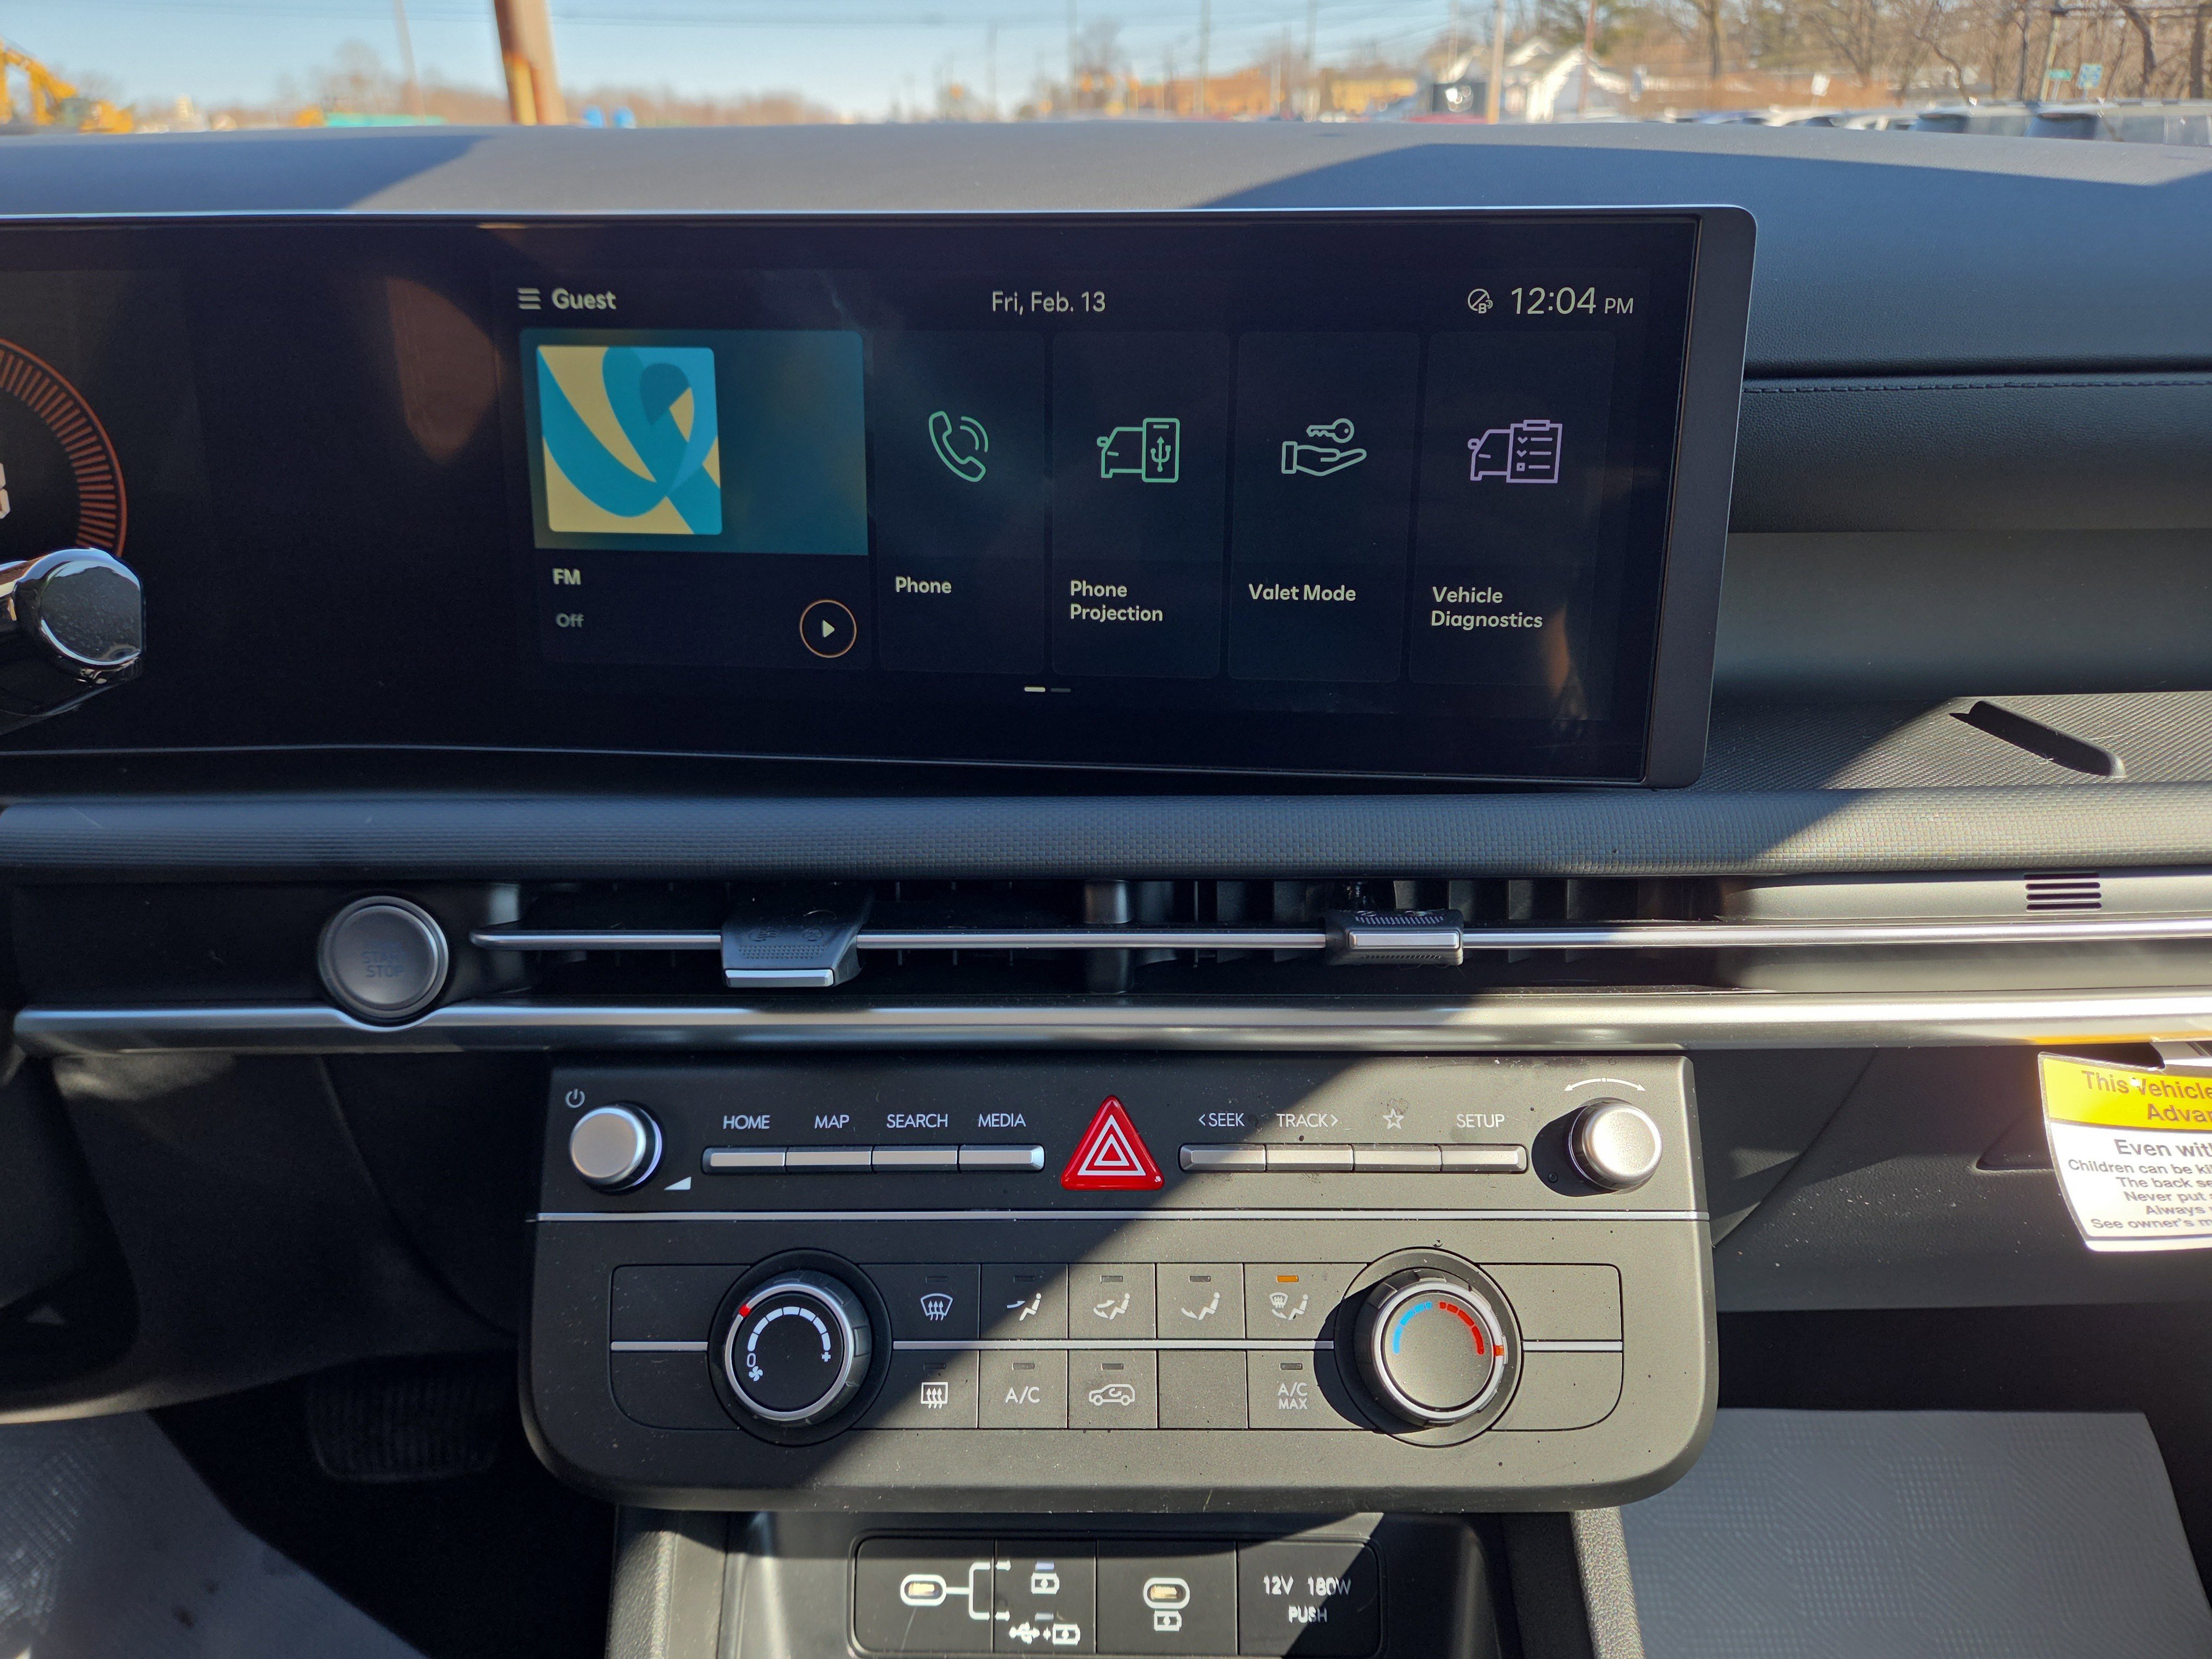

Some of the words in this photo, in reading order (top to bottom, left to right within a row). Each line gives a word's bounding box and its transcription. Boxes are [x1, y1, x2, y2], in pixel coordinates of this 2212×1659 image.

[551, 287, 617, 310] Guest
[992, 290, 1024, 316] Fri,
[1031, 290, 1075, 313] Feb.
[1081, 291, 1106, 313] 13
[1511, 287, 1597, 314] 12:04
[1604, 297, 1634, 314] PM
[552, 567, 582, 586] FM
[895, 576, 952, 594] Phone
[1070, 580, 1128, 598] Phone
[1248, 583, 1300, 601] Valet
[1303, 583, 1356, 602] Mode
[1432, 586, 1503, 604] Vehicle
[555, 612, 585, 628] Off
[1070, 603, 1163, 623] Projection
[1431, 609, 1544, 631] Diagnostics
[366, 964, 404, 978] STOP
[2081, 1070, 2130, 1094] This
[723, 1114, 771, 1130] HOME
[814, 1114, 850, 1129] MAP
[886, 1113, 949, 1129] SEARCH
[978, 1112, 1027, 1128] MEDIA
[1456, 1113, 1506, 1129] SETUP
[2114, 1139, 2172, 1156] Even
[2068, 1159, 2135, 1173] Children
[2138, 1165, 2169, 1174] can
[2170, 1163, 2193, 1174] be
[2115, 1176, 2149, 1188] The
[2151, 1178, 2194, 1188] back
[2123, 1191, 2172, 1201] Never
[2176, 1192, 2208, 1204] put
[2145, 1205, 2207, 1217] Always
[2091, 1218, 2124, 1229] See
[1005, 1386, 1040, 1404] A/C
[1277, 1381, 1308, 1397] A/C
[1278, 1398, 1308, 1410] MAX
[1263, 1574, 1294, 1596] 12V
[1307, 1575, 1352, 1596] 180W
[1288, 1604, 1328, 1624] PUSH
